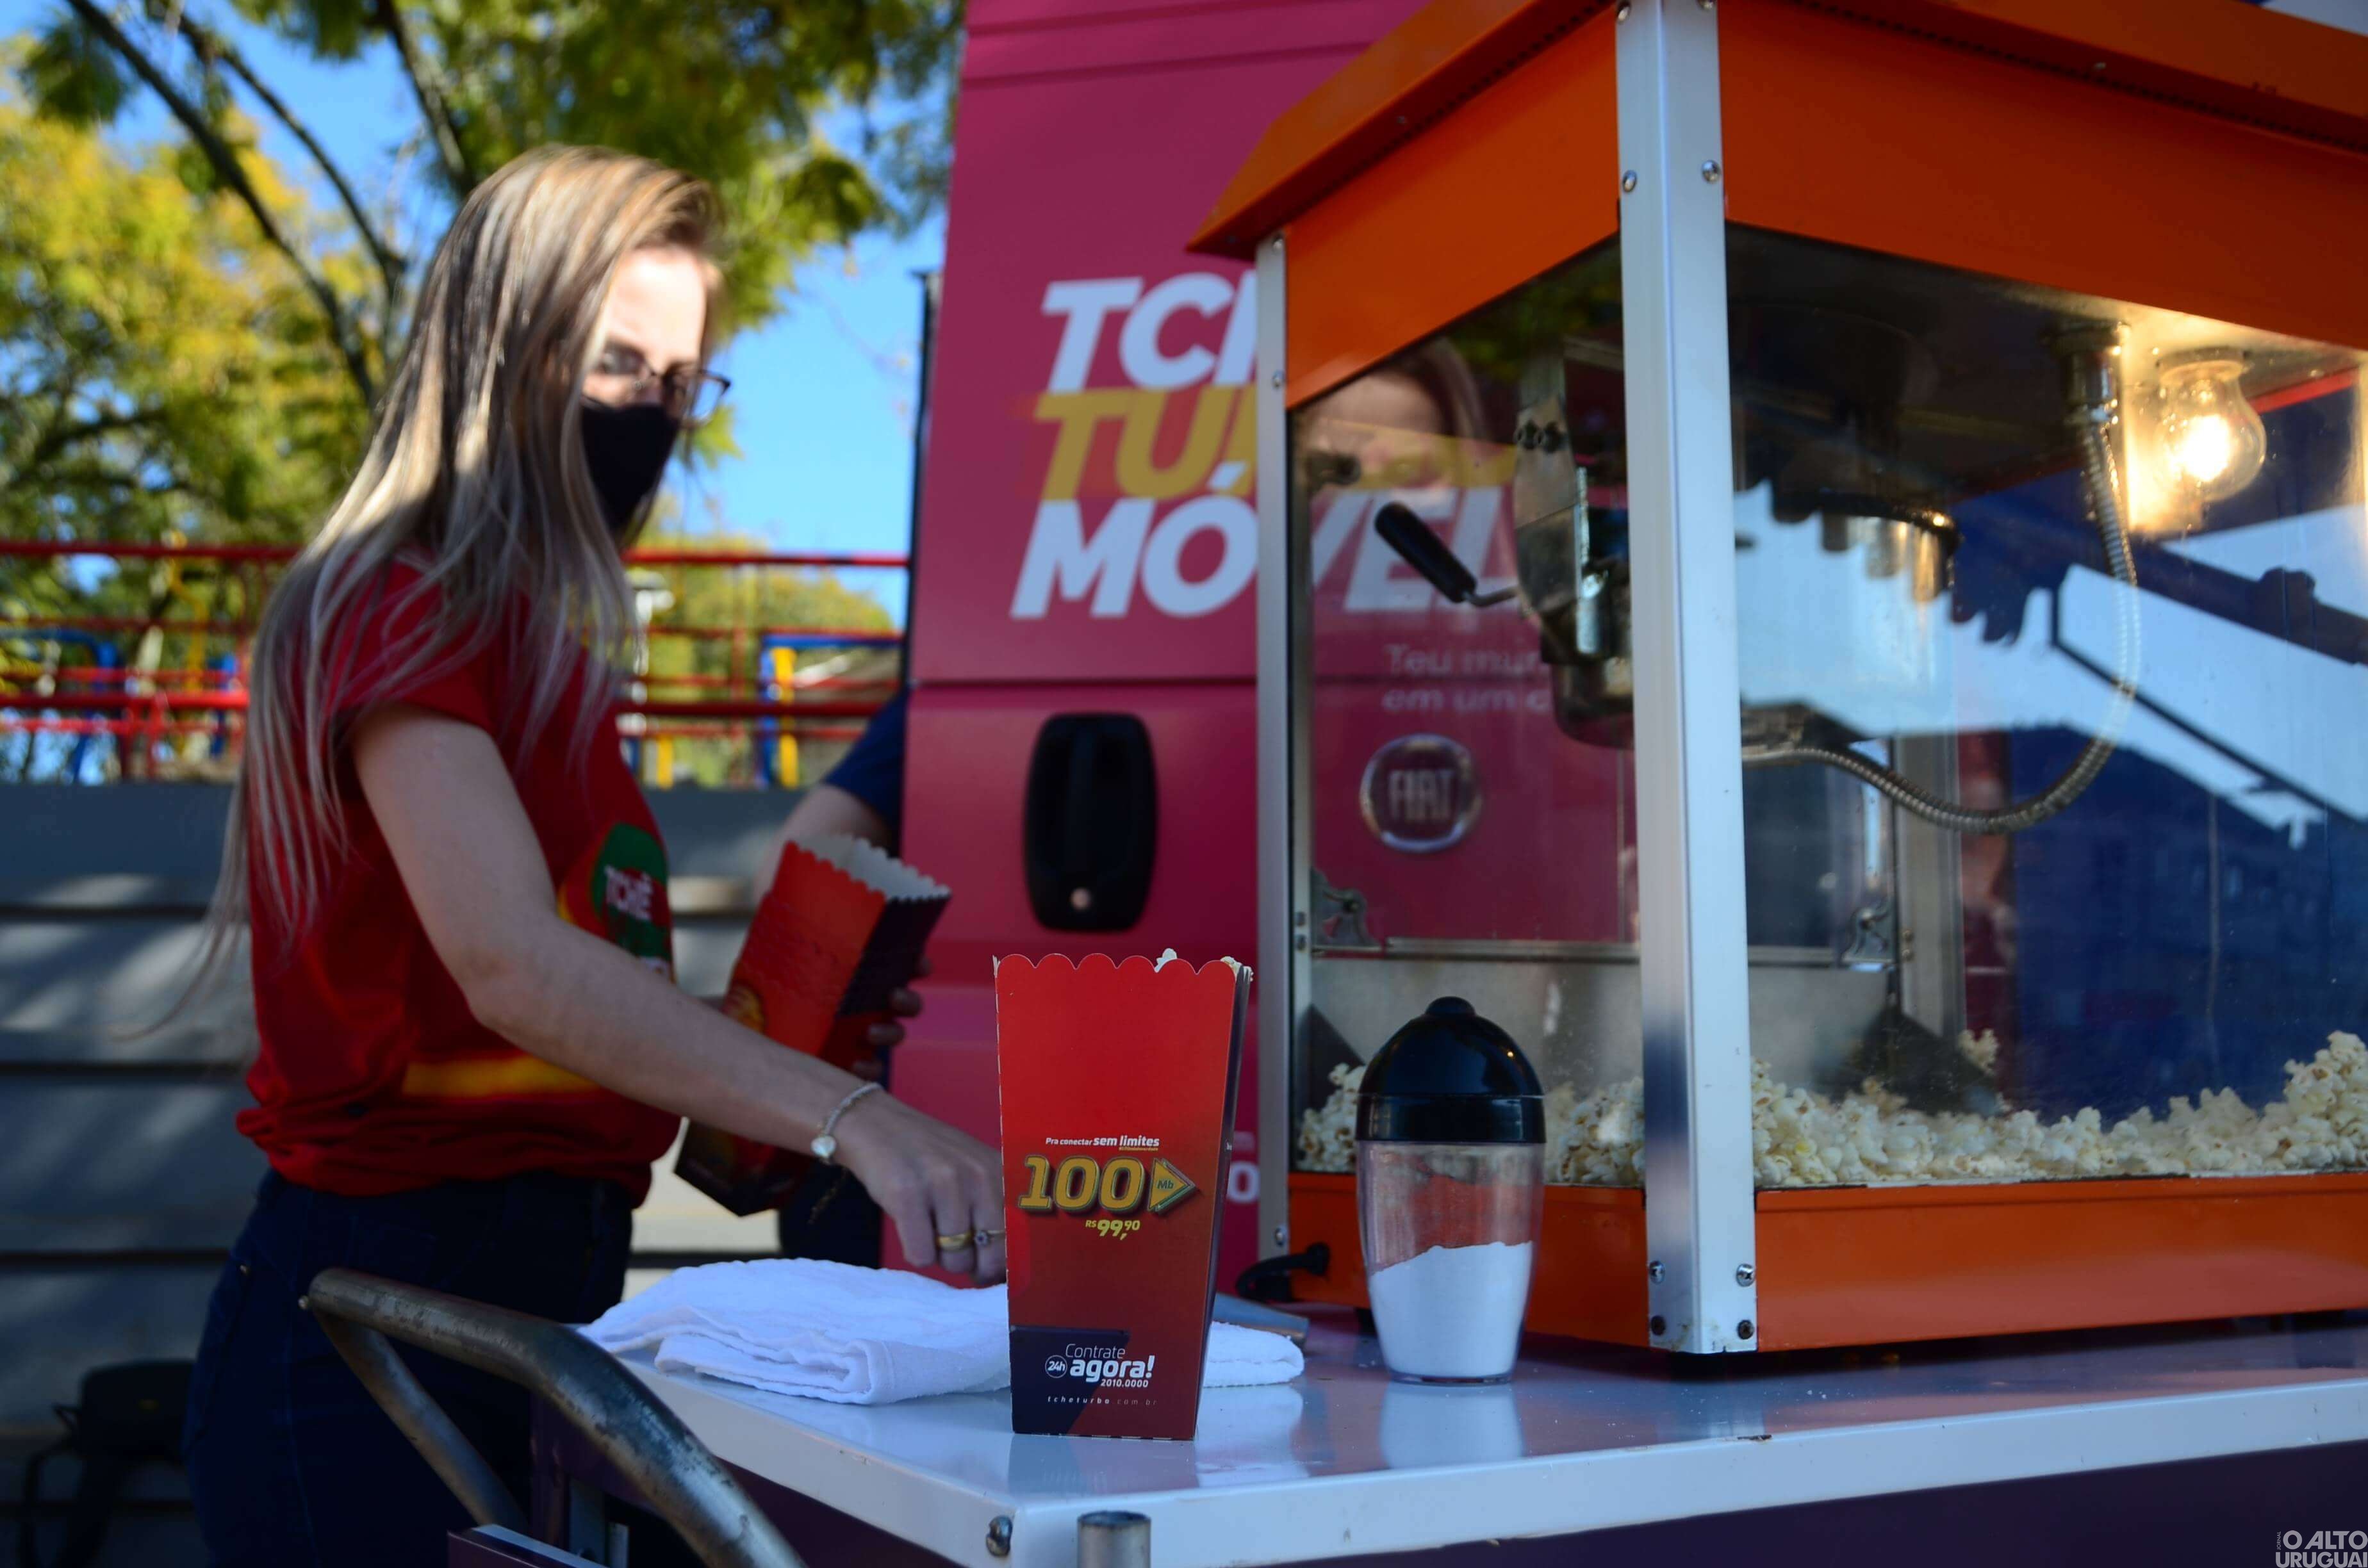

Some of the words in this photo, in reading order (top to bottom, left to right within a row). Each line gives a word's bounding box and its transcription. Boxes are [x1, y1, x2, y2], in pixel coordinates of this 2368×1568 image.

[1387, 769, 1456, 824] FIAT
[1045, 1136, 1058, 1145] Pra
[1060, 1138, 1092, 1146] conectar
[1093, 1136, 1117, 1147] sem
[1119, 1134, 1160, 1147] limites
[1018, 1155, 1146, 1213] 100
[1156, 1180, 1174, 1189] Mb
[1065, 1343, 1126, 1359] Contrate
[1047, 1360, 1066, 1372] 24h
[1069, 1355, 1156, 1383] agora!
[1100, 1378, 1149, 1388] 2010.0000
